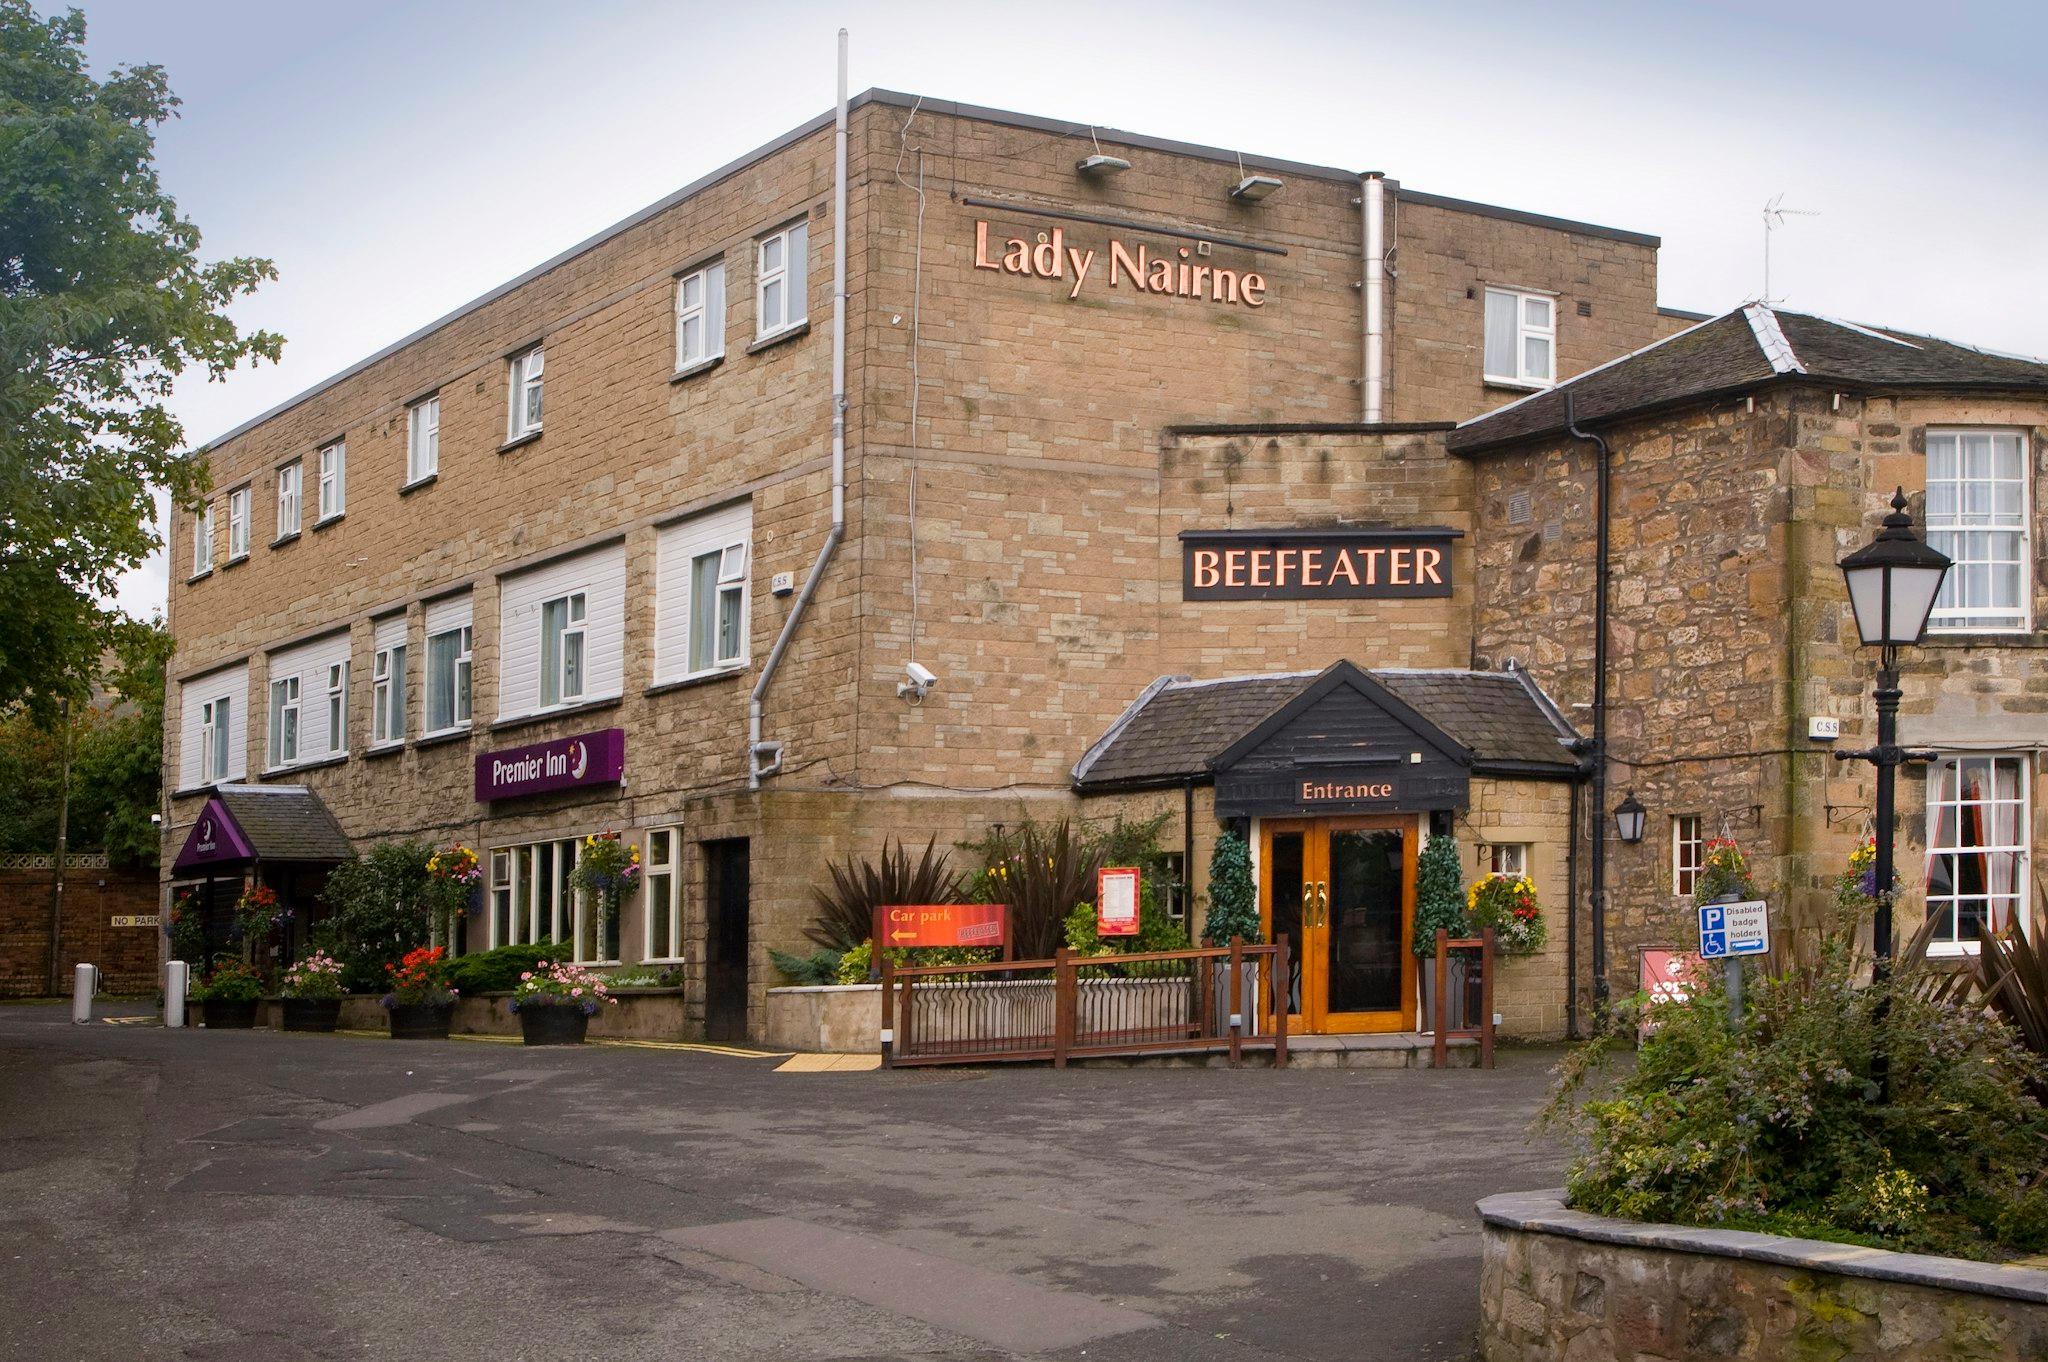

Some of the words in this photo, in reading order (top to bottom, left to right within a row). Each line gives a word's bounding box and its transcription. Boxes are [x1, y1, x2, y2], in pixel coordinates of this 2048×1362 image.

[975, 220, 1094, 300] Lady
[1109, 239, 1267, 308] Nairne
[1193, 548, 1443, 588] BEEFEATER
[493, 754, 543, 786] Premier
[546, 750, 567, 777] Inn
[1302, 781, 1392, 800] Entrance
[890, 909, 915, 922] Car
[920, 909, 951, 925] park
[1726, 905, 1763, 916] Disabled
[114, 916, 129, 925] NO
[1706, 909, 1721, 930] P
[1732, 918, 1758, 927] badge
[1730, 930, 1762, 938] holders
